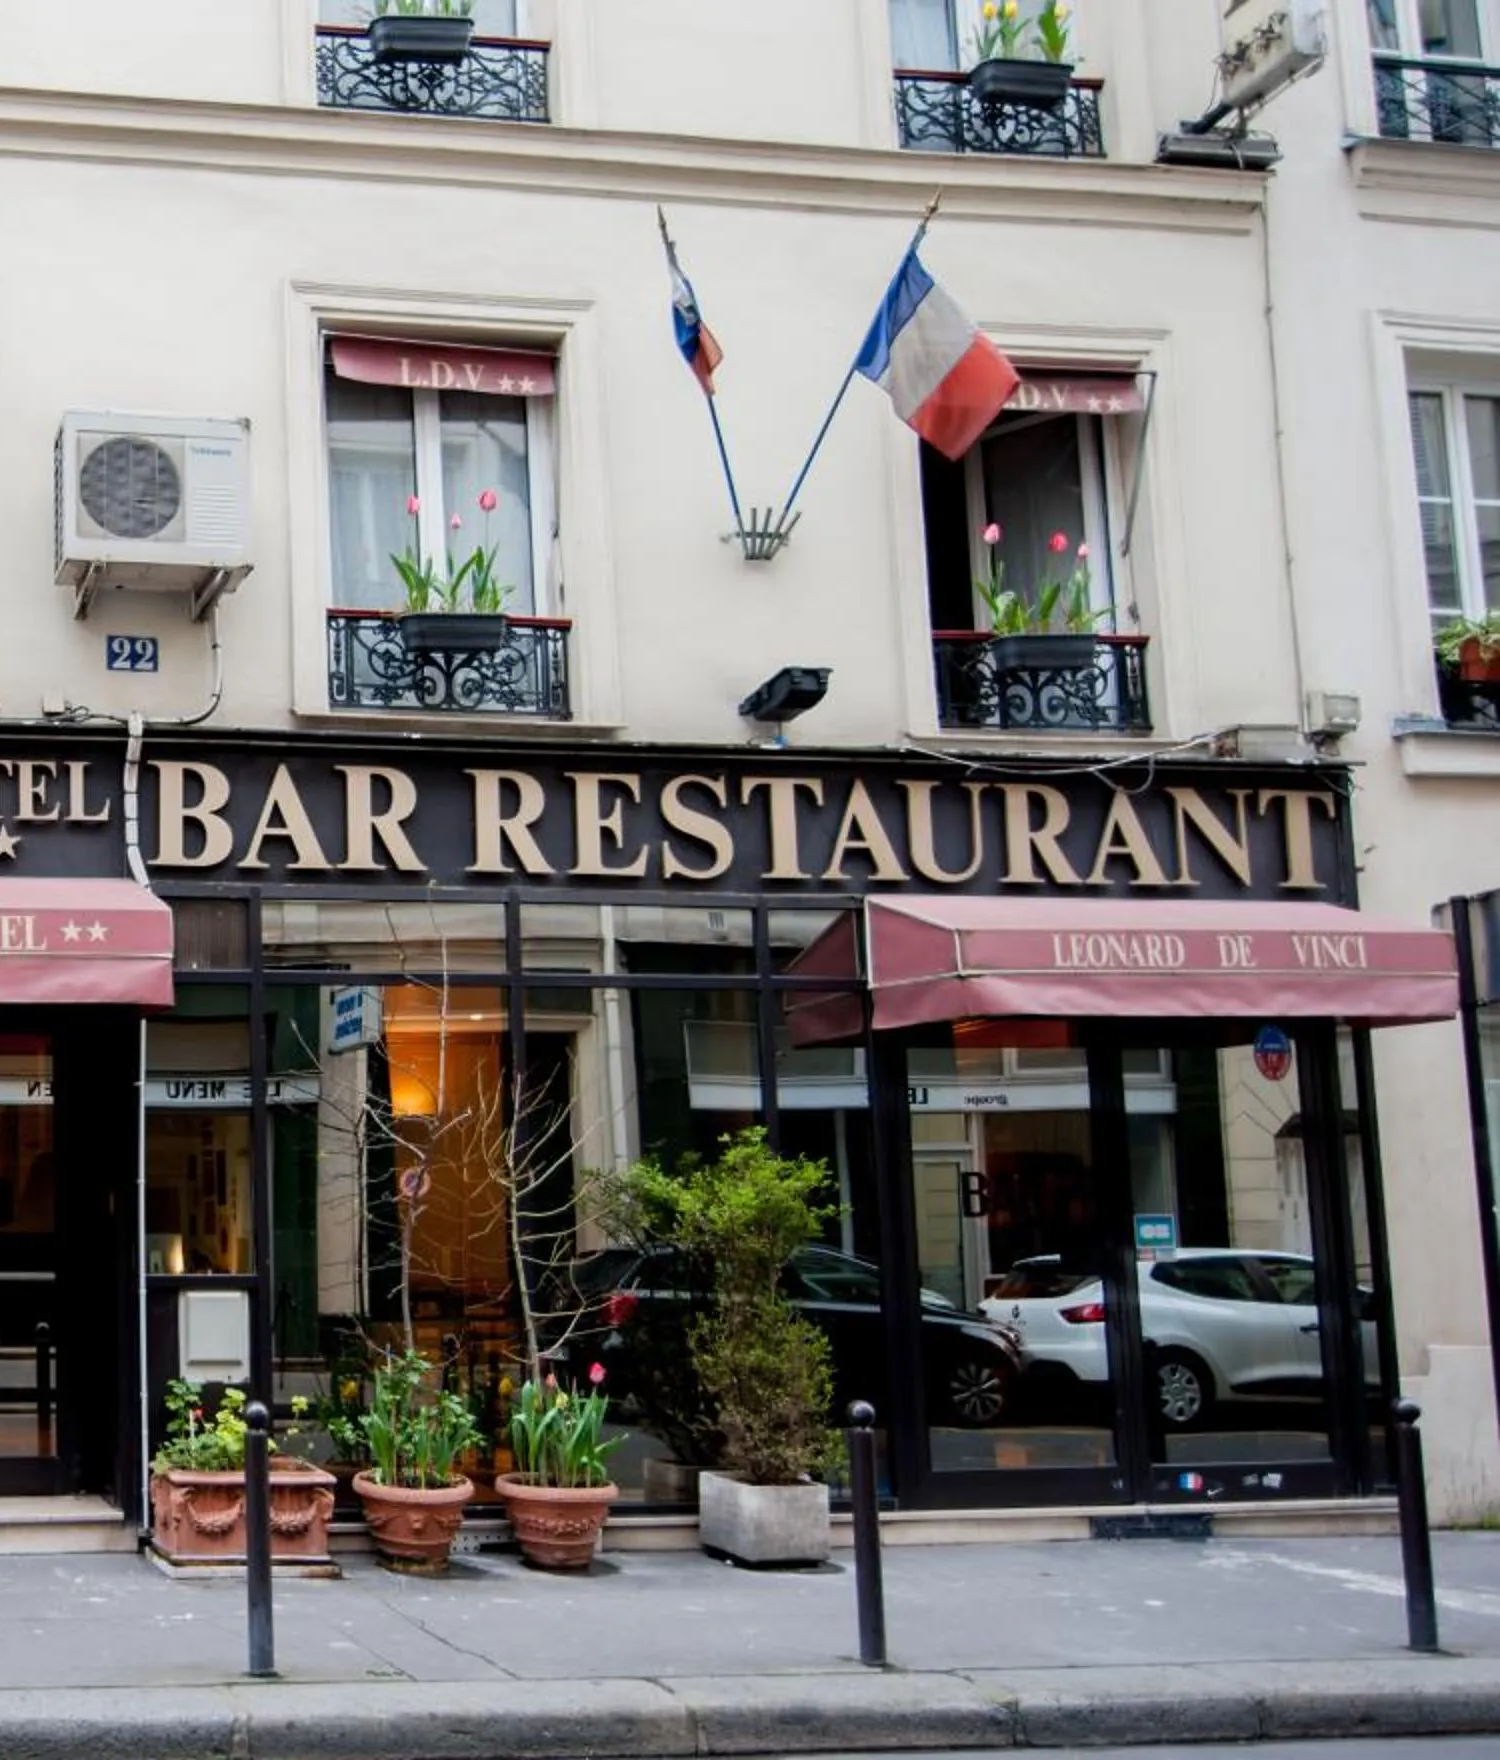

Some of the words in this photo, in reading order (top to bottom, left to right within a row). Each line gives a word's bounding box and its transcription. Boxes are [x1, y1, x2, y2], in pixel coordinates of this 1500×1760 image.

[398, 357, 484, 390] L.D.V
[111, 637, 155, 671] 22
[147, 759, 428, 873] BAR
[462, 766, 1336, 890] RESTAURANT
[1051, 932, 1186, 969] LEONARD
[1218, 935, 1258, 969] DE
[1290, 936, 1368, 970] VINCI
